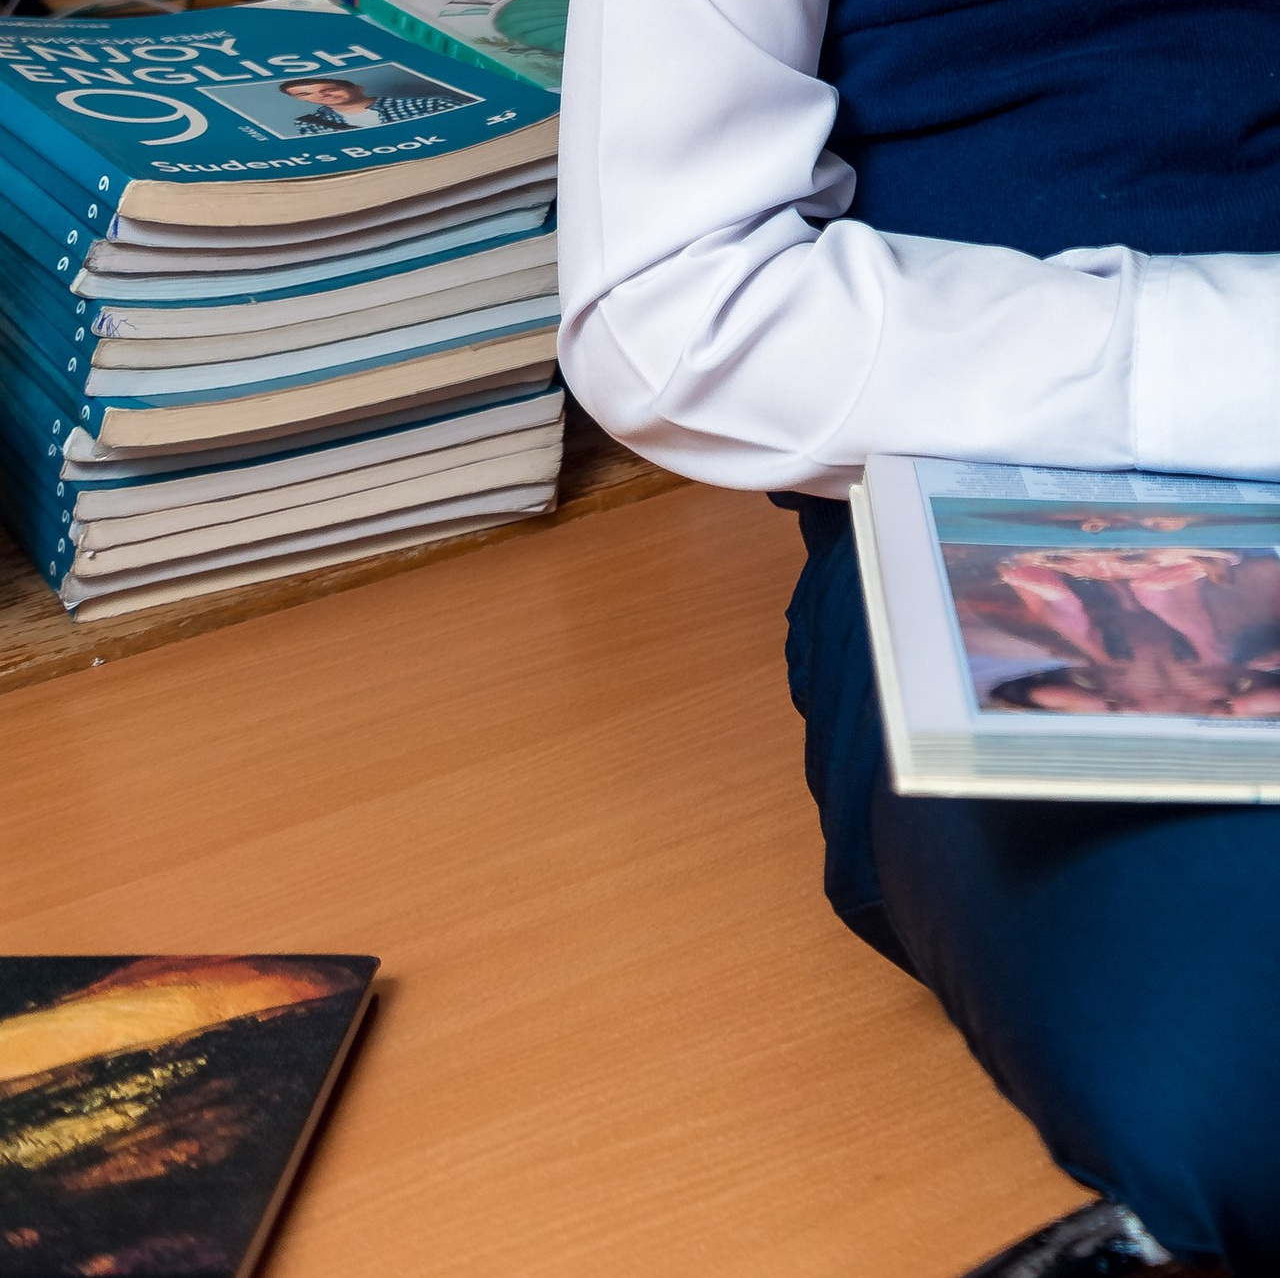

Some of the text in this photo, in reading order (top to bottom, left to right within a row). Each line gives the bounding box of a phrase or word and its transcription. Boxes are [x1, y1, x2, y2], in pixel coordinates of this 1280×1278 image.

[8, 45, 383, 86] ENGLISH
[55, 88, 209, 146] 9
[150, 134, 448, 173] Student's Book
